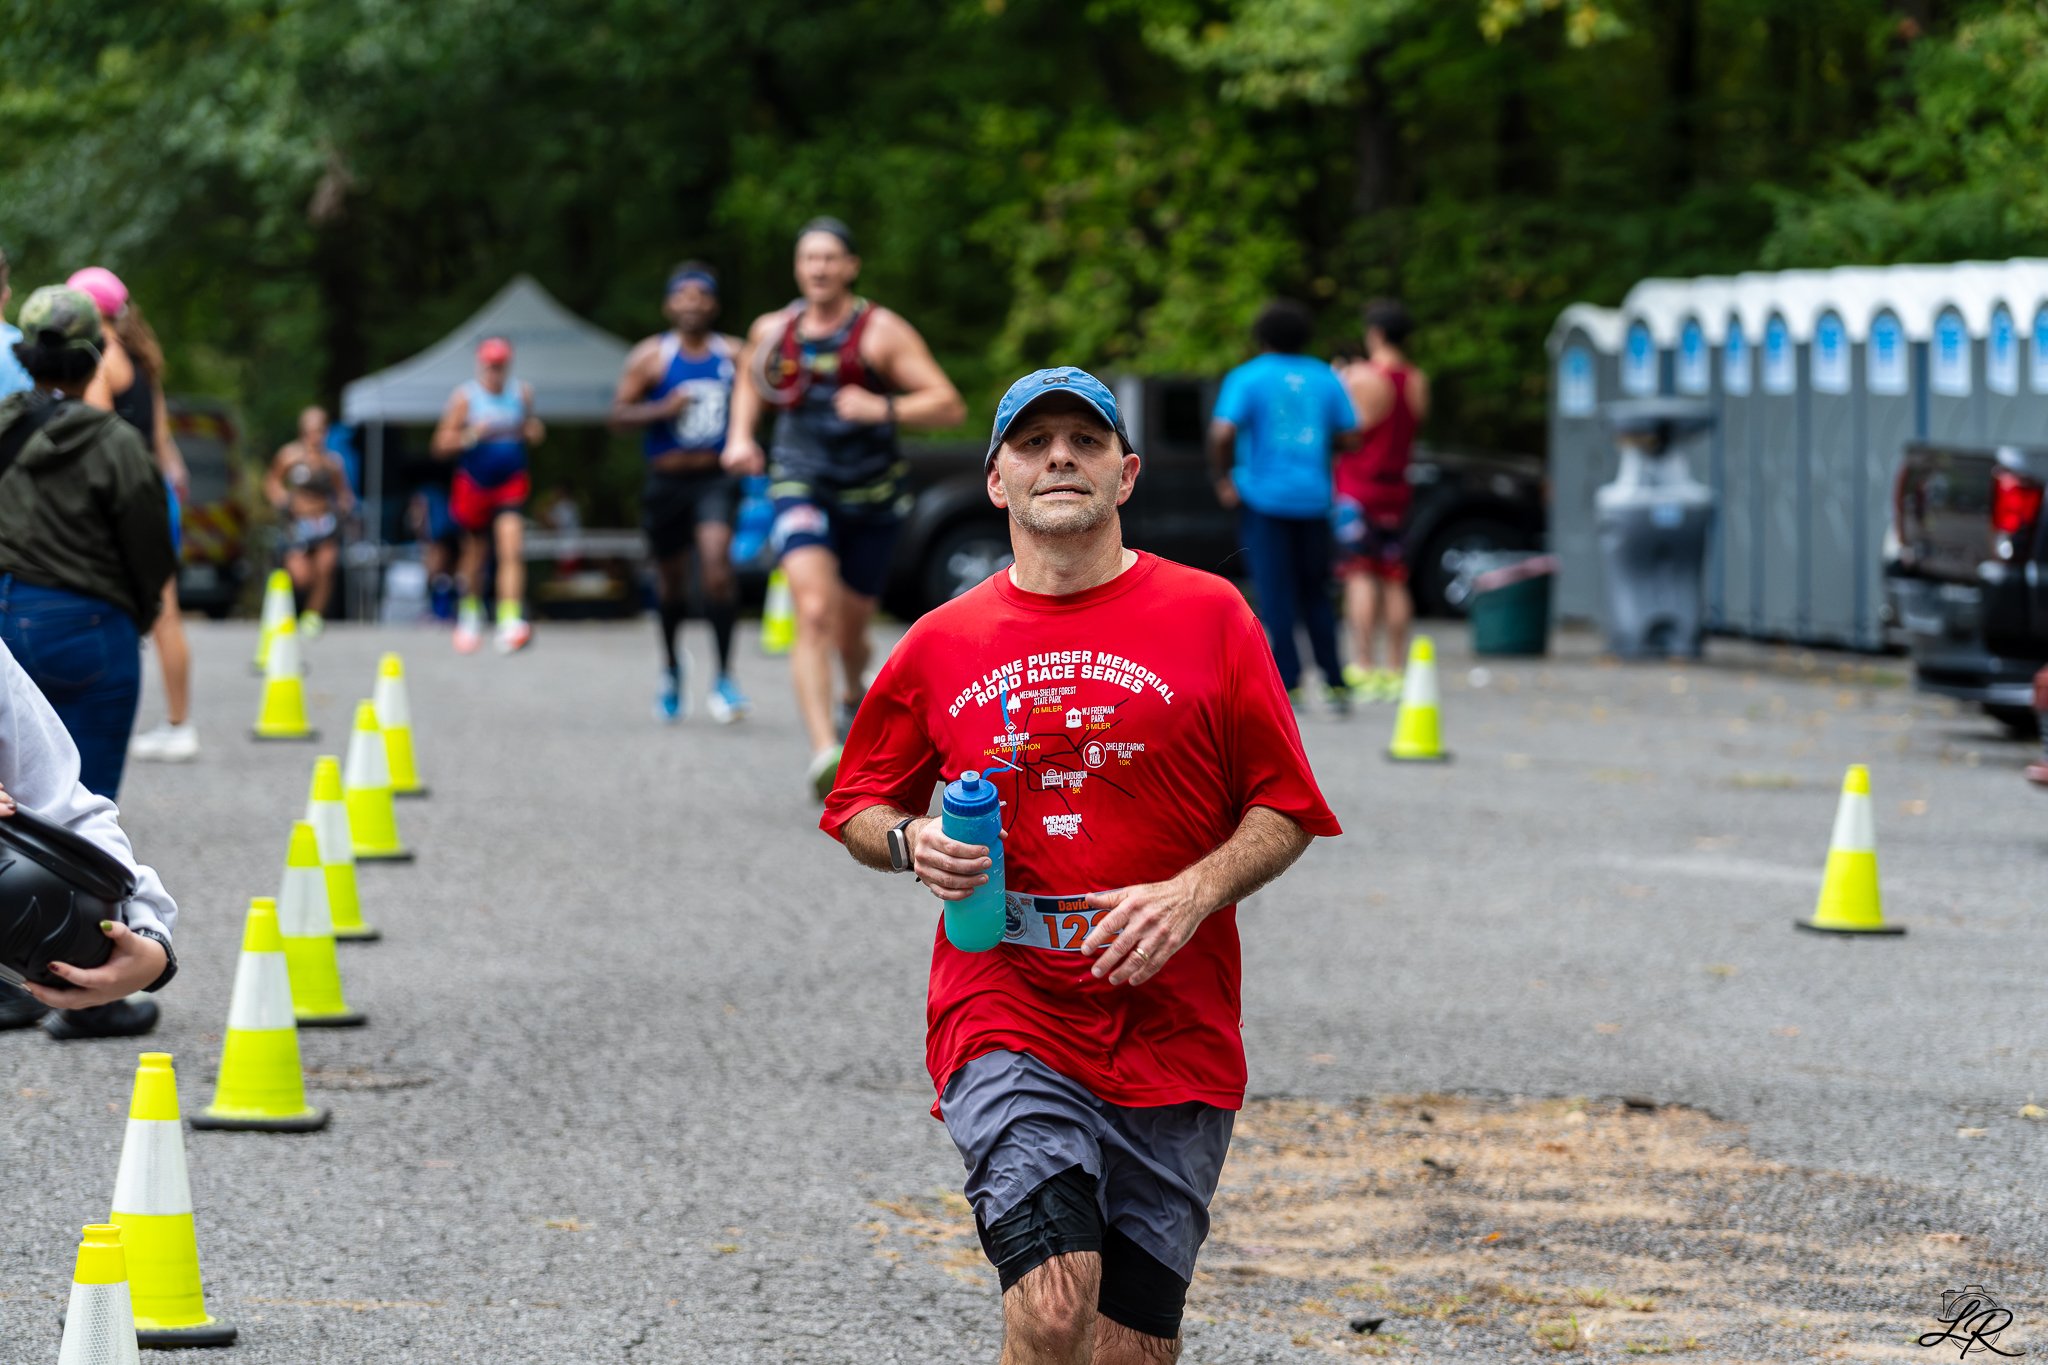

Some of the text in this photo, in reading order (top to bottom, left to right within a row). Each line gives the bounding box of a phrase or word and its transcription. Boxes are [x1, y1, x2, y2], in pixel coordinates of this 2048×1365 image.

[949, 650, 1174, 718] 2024 LANE PURSER MEMORIAL
[975, 664, 1144, 707] ROAD RACE SERIES
[1059, 686, 1076, 696] FOREST
[1033, 695, 1062, 706] STATE PARK
[1040, 705, 1063, 713] MILER
[1081, 705, 1115, 716] WJ FREEMAN
[1090, 714, 1105, 723] PARK
[1085, 722, 1111, 731] 5 MILER
[993, 732, 1030, 744] BIG RIVER
[983, 747, 1000, 756] HALF
[1105, 742, 1145, 752] SHELBY FARMS
[1117, 750, 1133, 759] PARK
[1069, 779, 1083, 788] PARK
[1072, 787, 1081, 795] 5K
[1042, 813, 1082, 826] MEMPHIS
[1057, 899, 1089, 912] David
